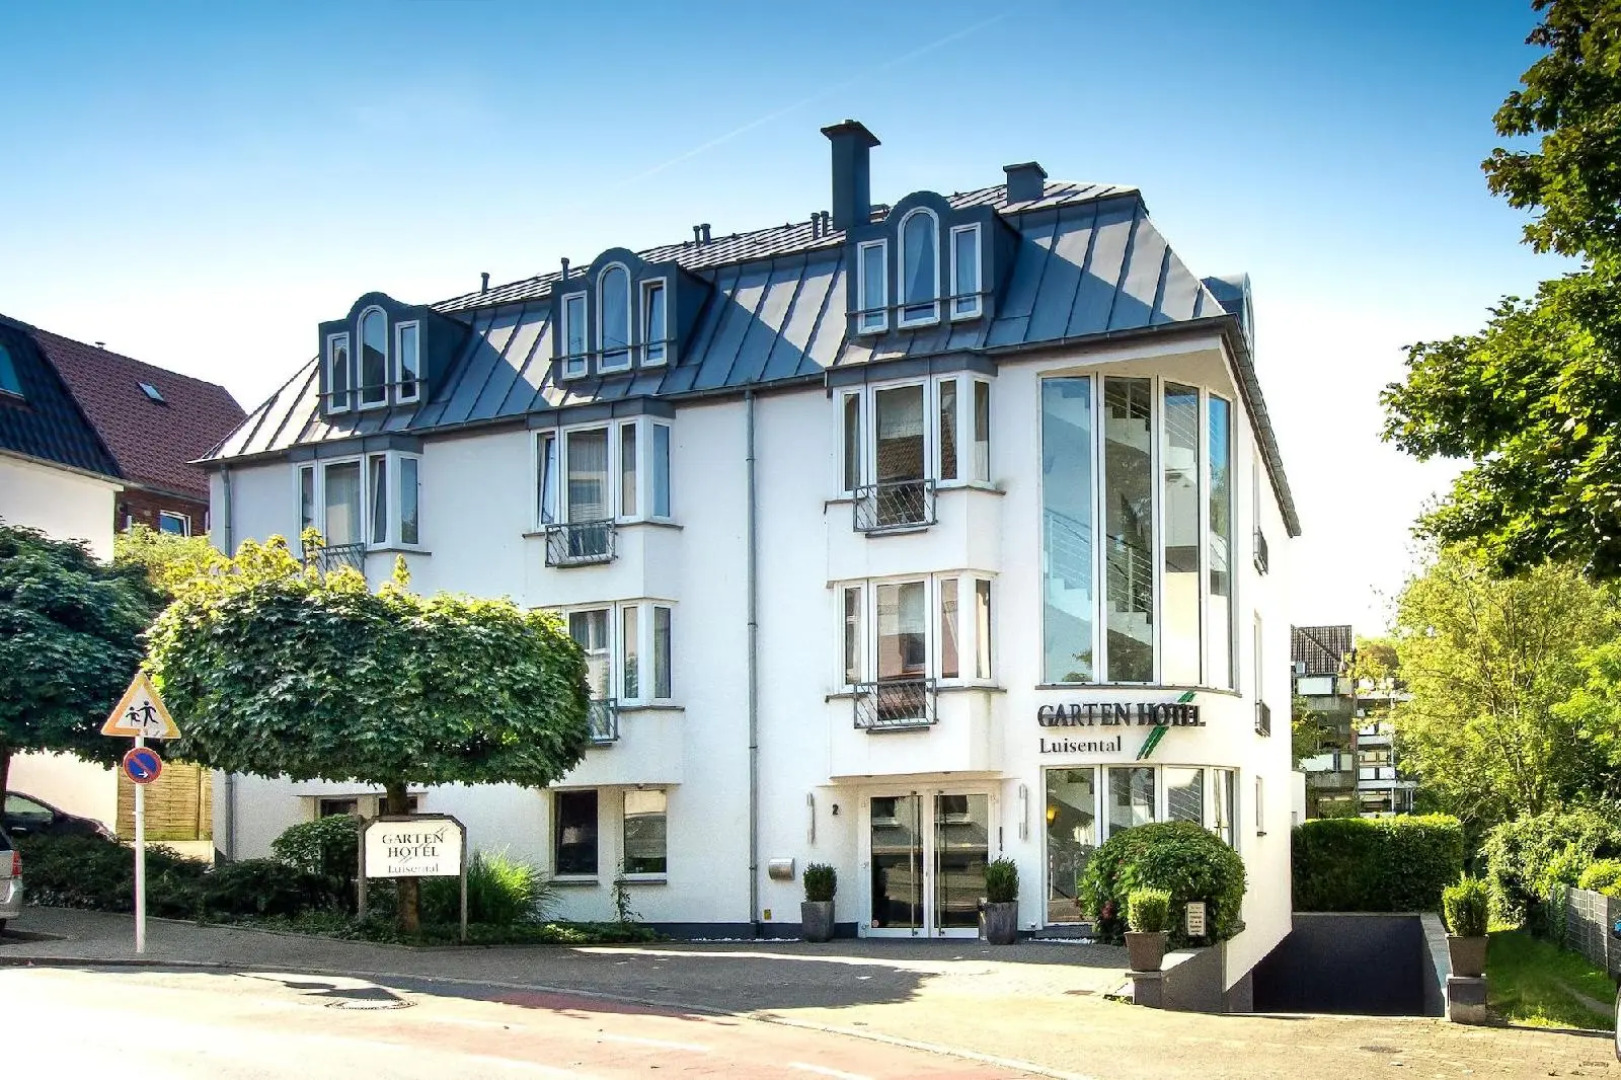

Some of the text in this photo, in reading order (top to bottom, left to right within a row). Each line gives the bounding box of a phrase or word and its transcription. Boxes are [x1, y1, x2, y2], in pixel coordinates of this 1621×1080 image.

[1037, 702, 1207, 727] GARTEN HOTEL
[1039, 735, 1122, 754] Luisental
[832, 803, 839, 816] 2
[382, 833, 444, 844] GARTEN
[388, 846, 439, 858] HOTEL
